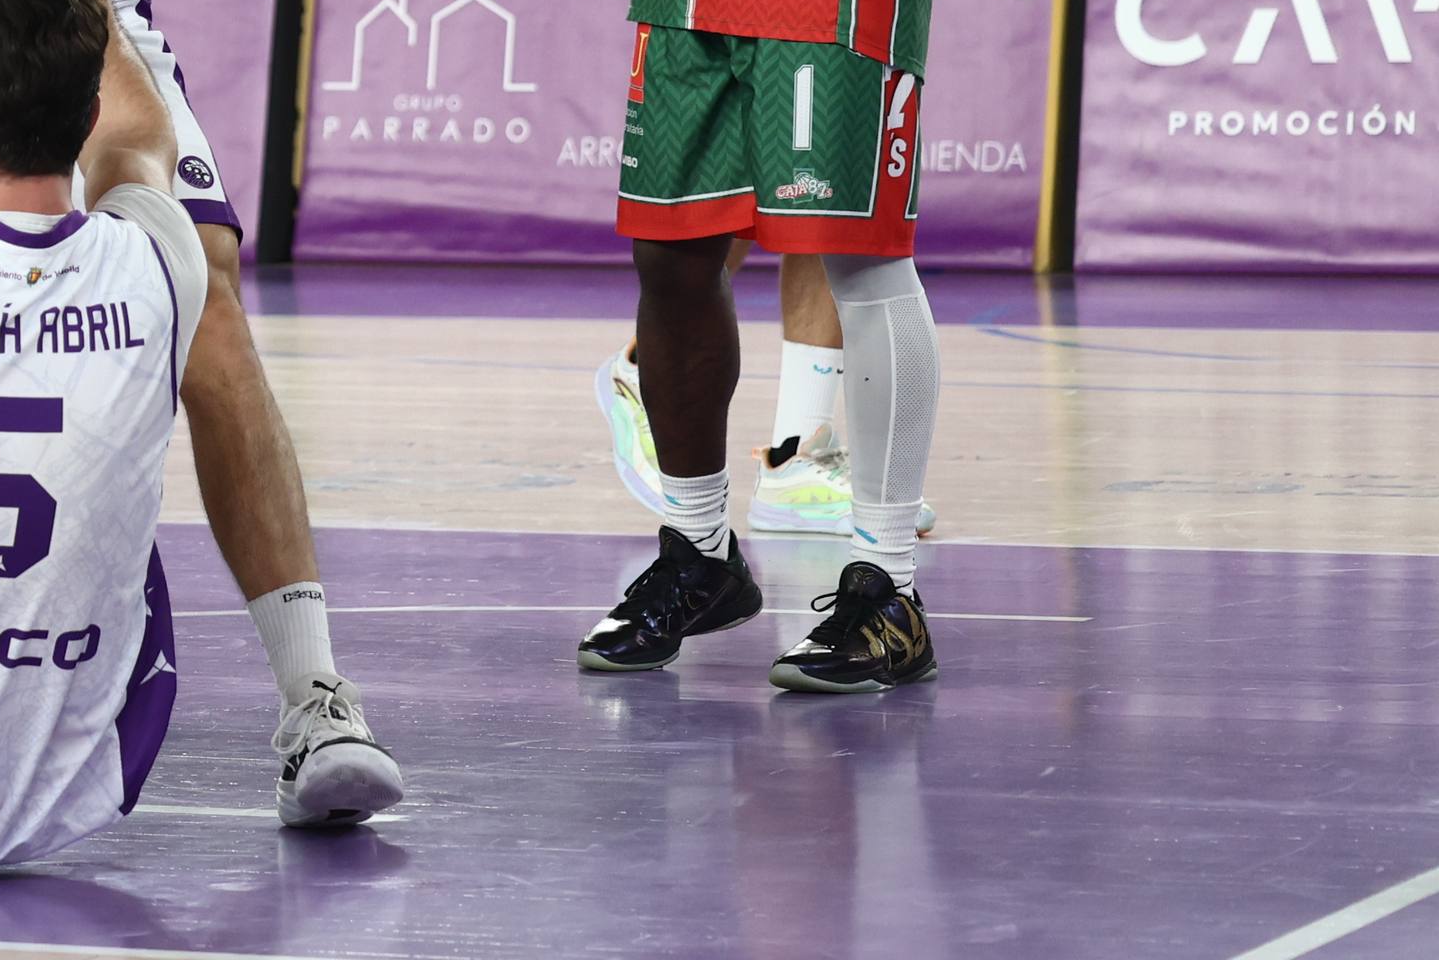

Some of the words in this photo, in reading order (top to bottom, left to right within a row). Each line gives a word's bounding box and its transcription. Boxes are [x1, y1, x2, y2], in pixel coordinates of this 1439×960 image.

[393, 93, 463, 112] GRUPO
[792, 64, 814, 151] 1
[322, 116, 532, 144] PARRADO
[1168, 103, 1415, 136] PROMOCIÓN
[37, 301, 145, 354] ABRIL
